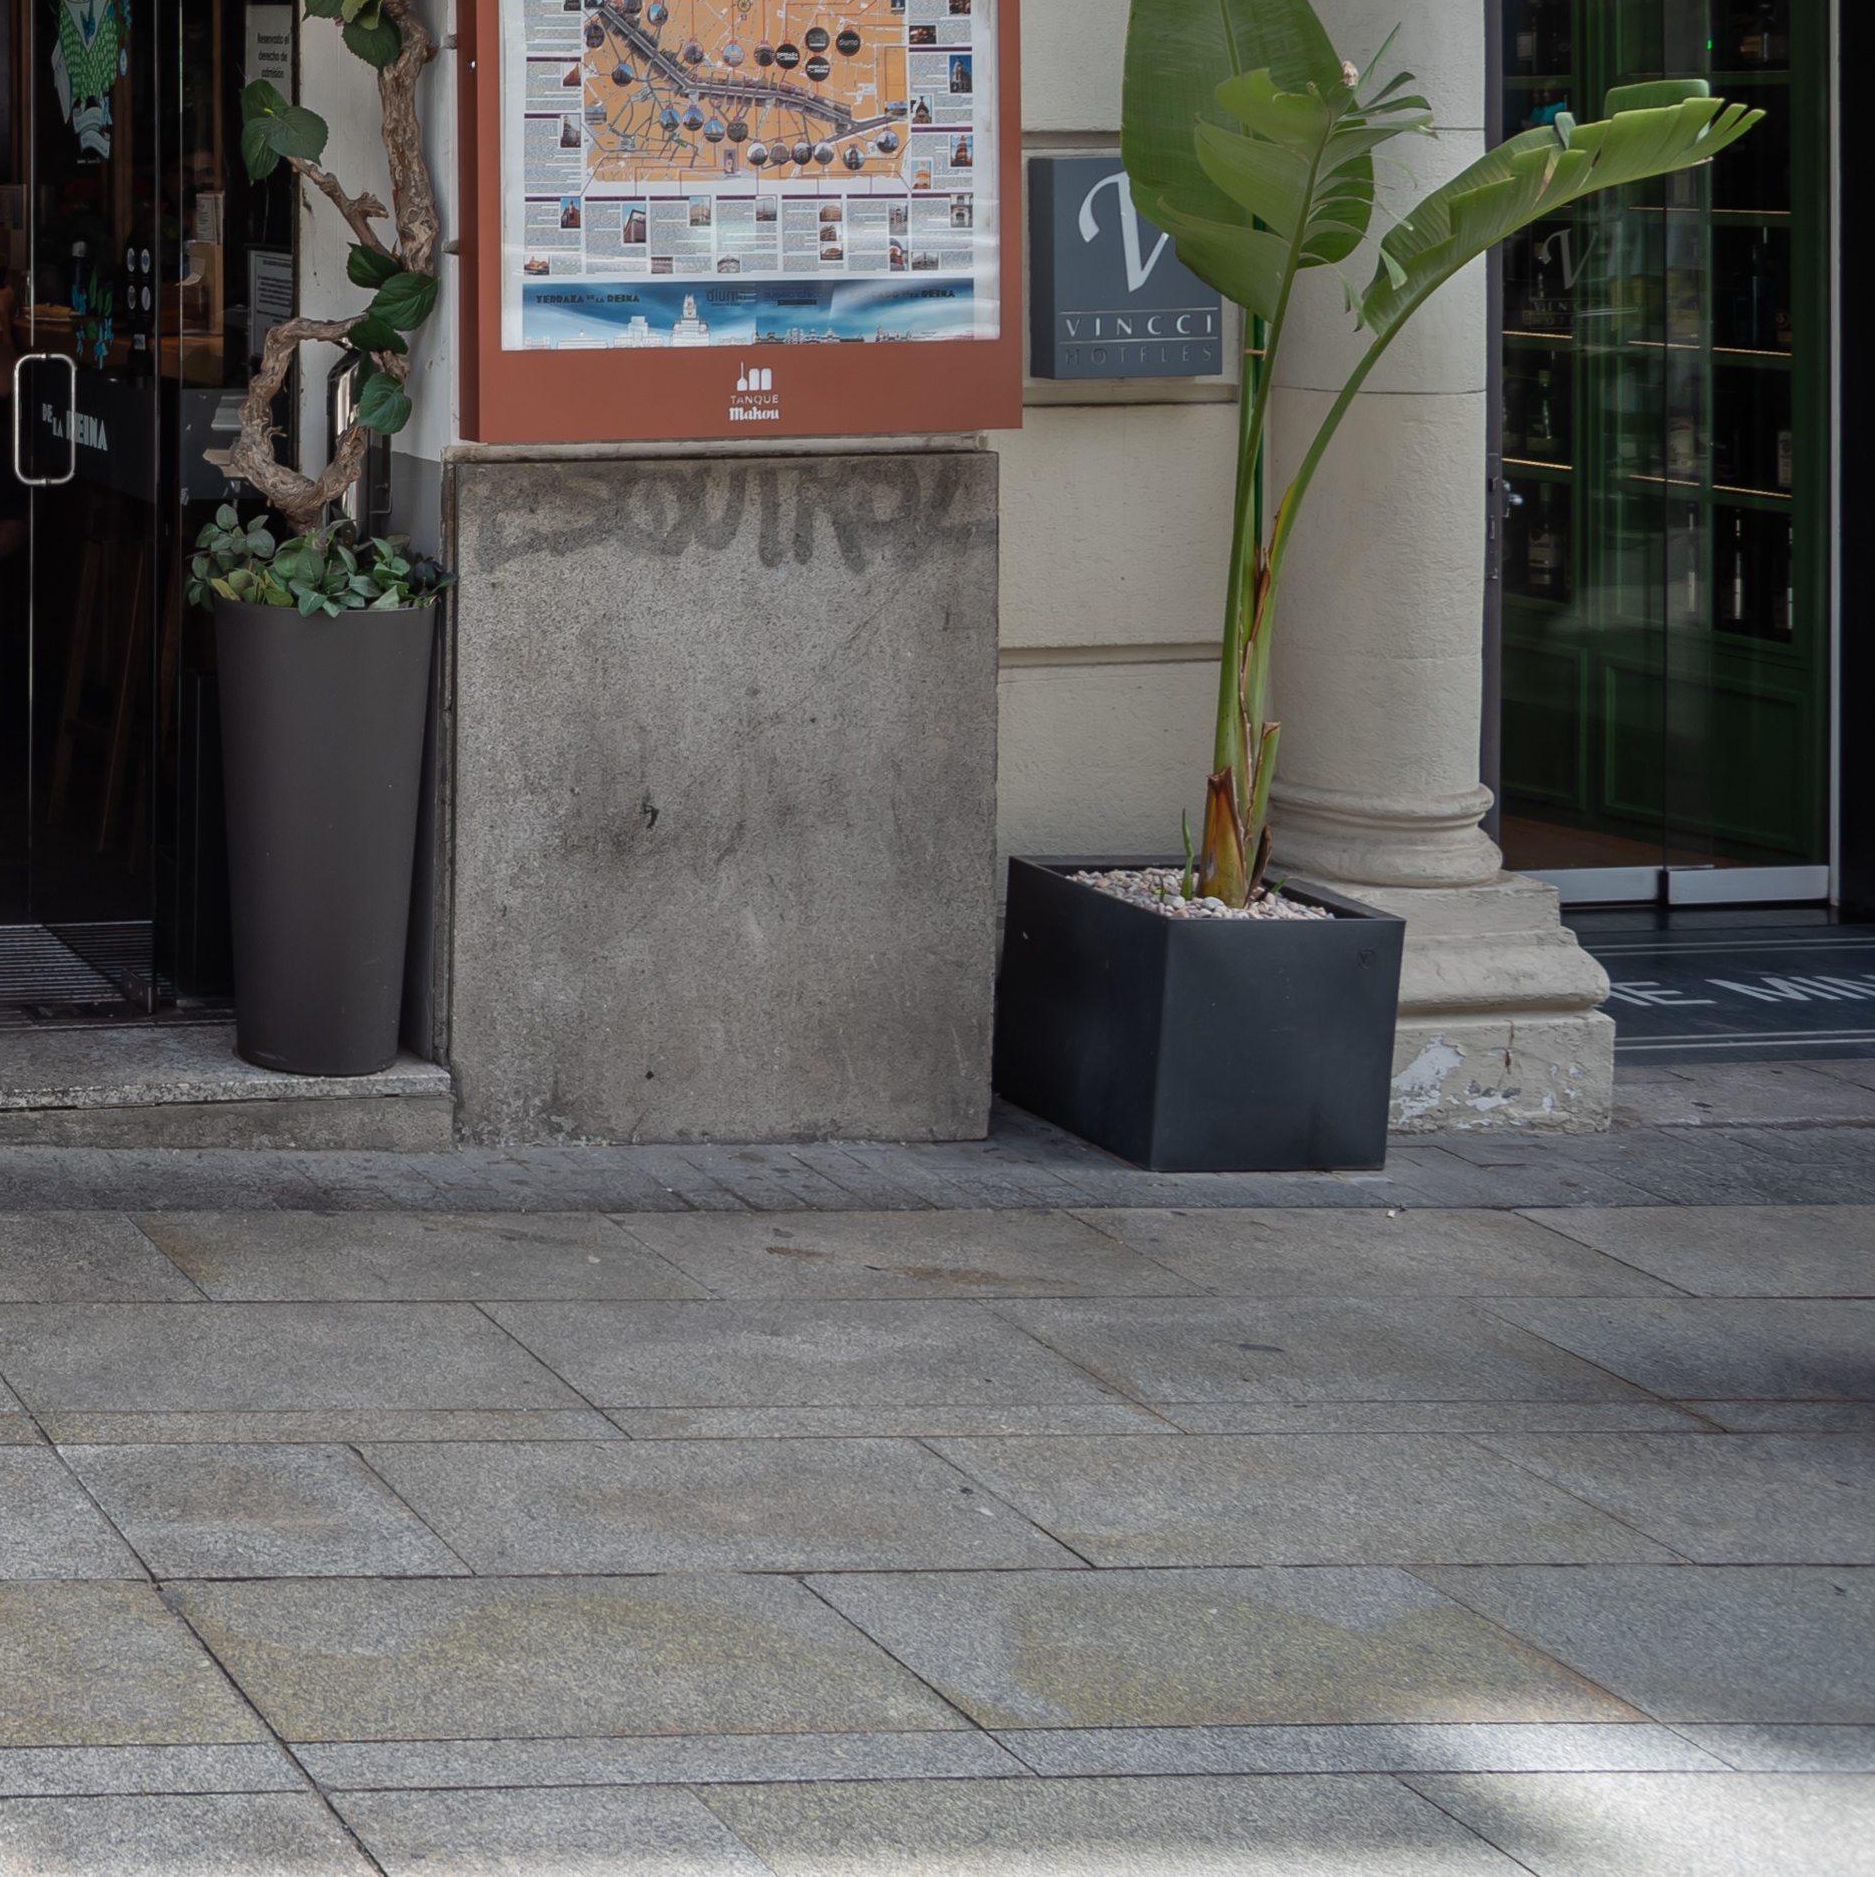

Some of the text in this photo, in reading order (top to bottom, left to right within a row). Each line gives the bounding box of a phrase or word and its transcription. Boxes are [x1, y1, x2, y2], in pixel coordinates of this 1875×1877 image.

[256, 31, 284, 46] Reservado
[257, 50, 289, 63] derecho de
[261, 65, 285, 81] admisión
[536, 294, 584, 304] TERRAZA
[607, 294, 640, 303] REINA
[1064, 312, 1216, 339] VINCCI
[1064, 345, 1216, 365] HOTELES
[730, 394, 780, 405] TANQUE
[42, 402, 53, 423] DE
[52, 416, 64, 438] LA
[728, 406, 780, 422] Mahou
